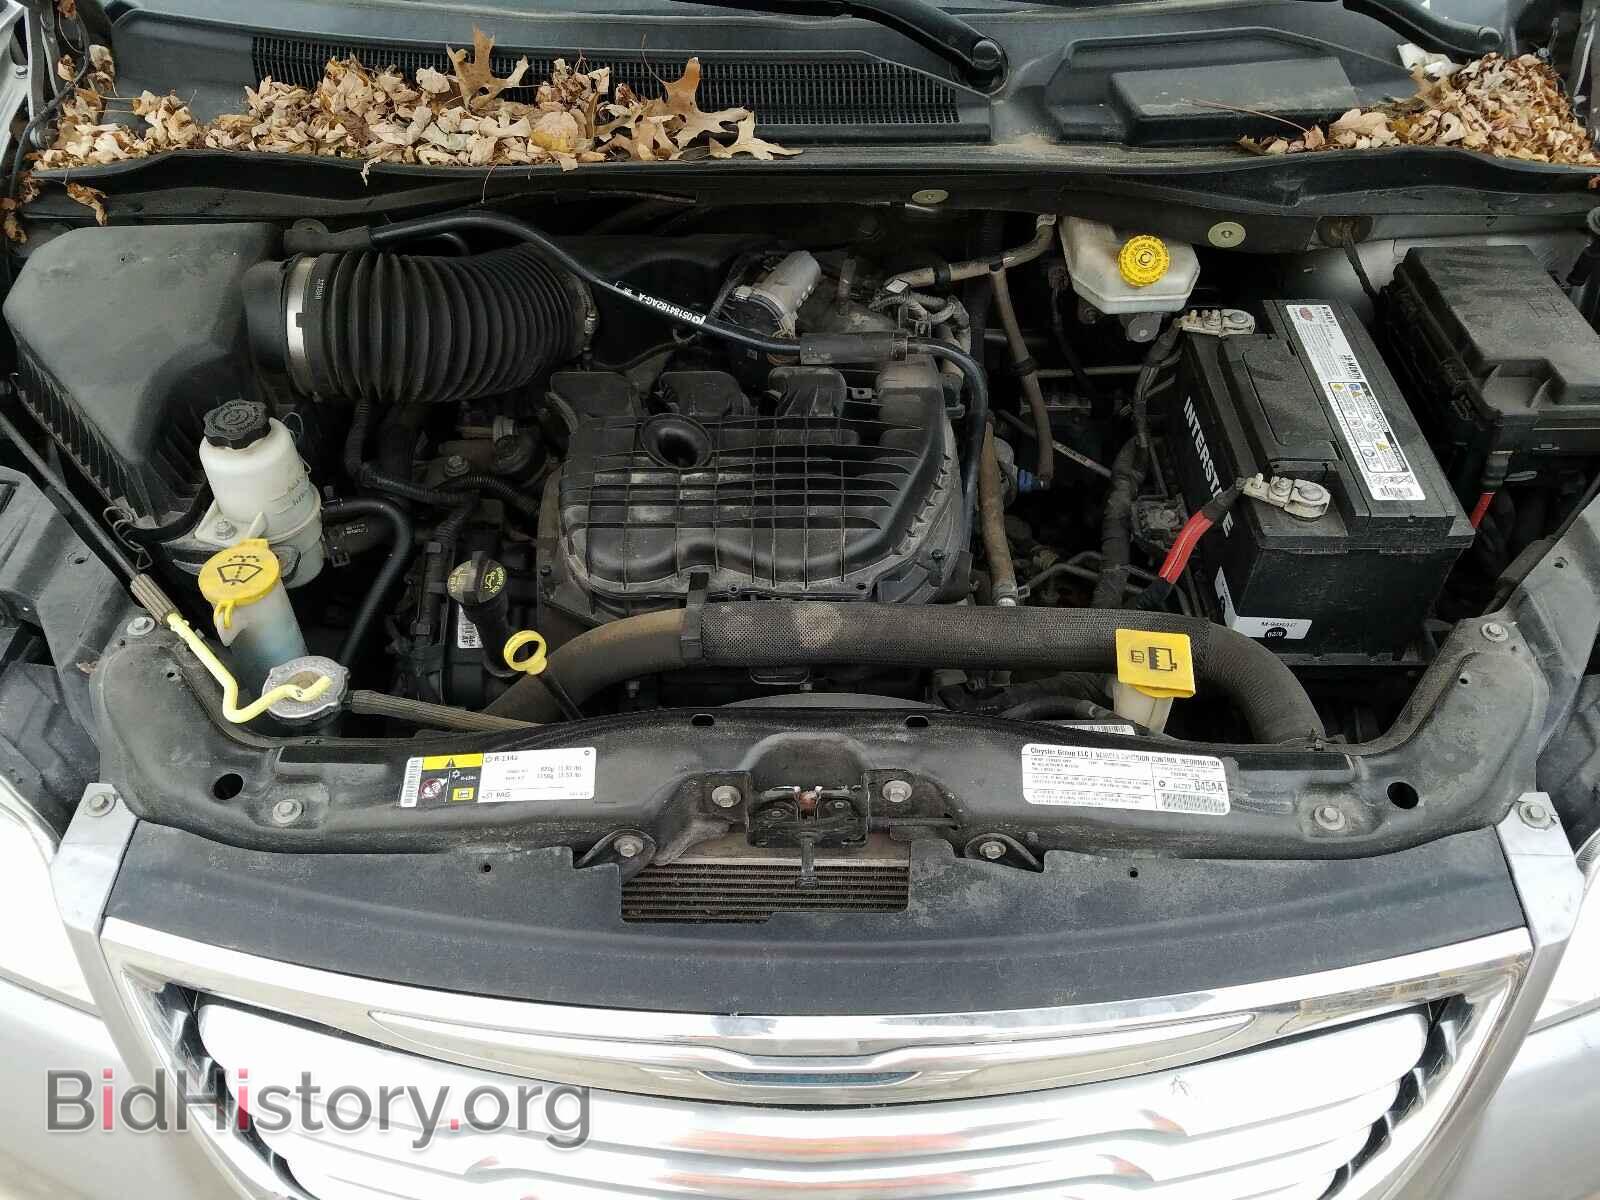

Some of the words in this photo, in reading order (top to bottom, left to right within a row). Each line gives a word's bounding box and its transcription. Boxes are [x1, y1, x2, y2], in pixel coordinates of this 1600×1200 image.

[1183, 395, 1234, 537] INTERSTE
[1030, 747, 1056, 755] Chrysler
[1057, 749, 1076, 757] Group
